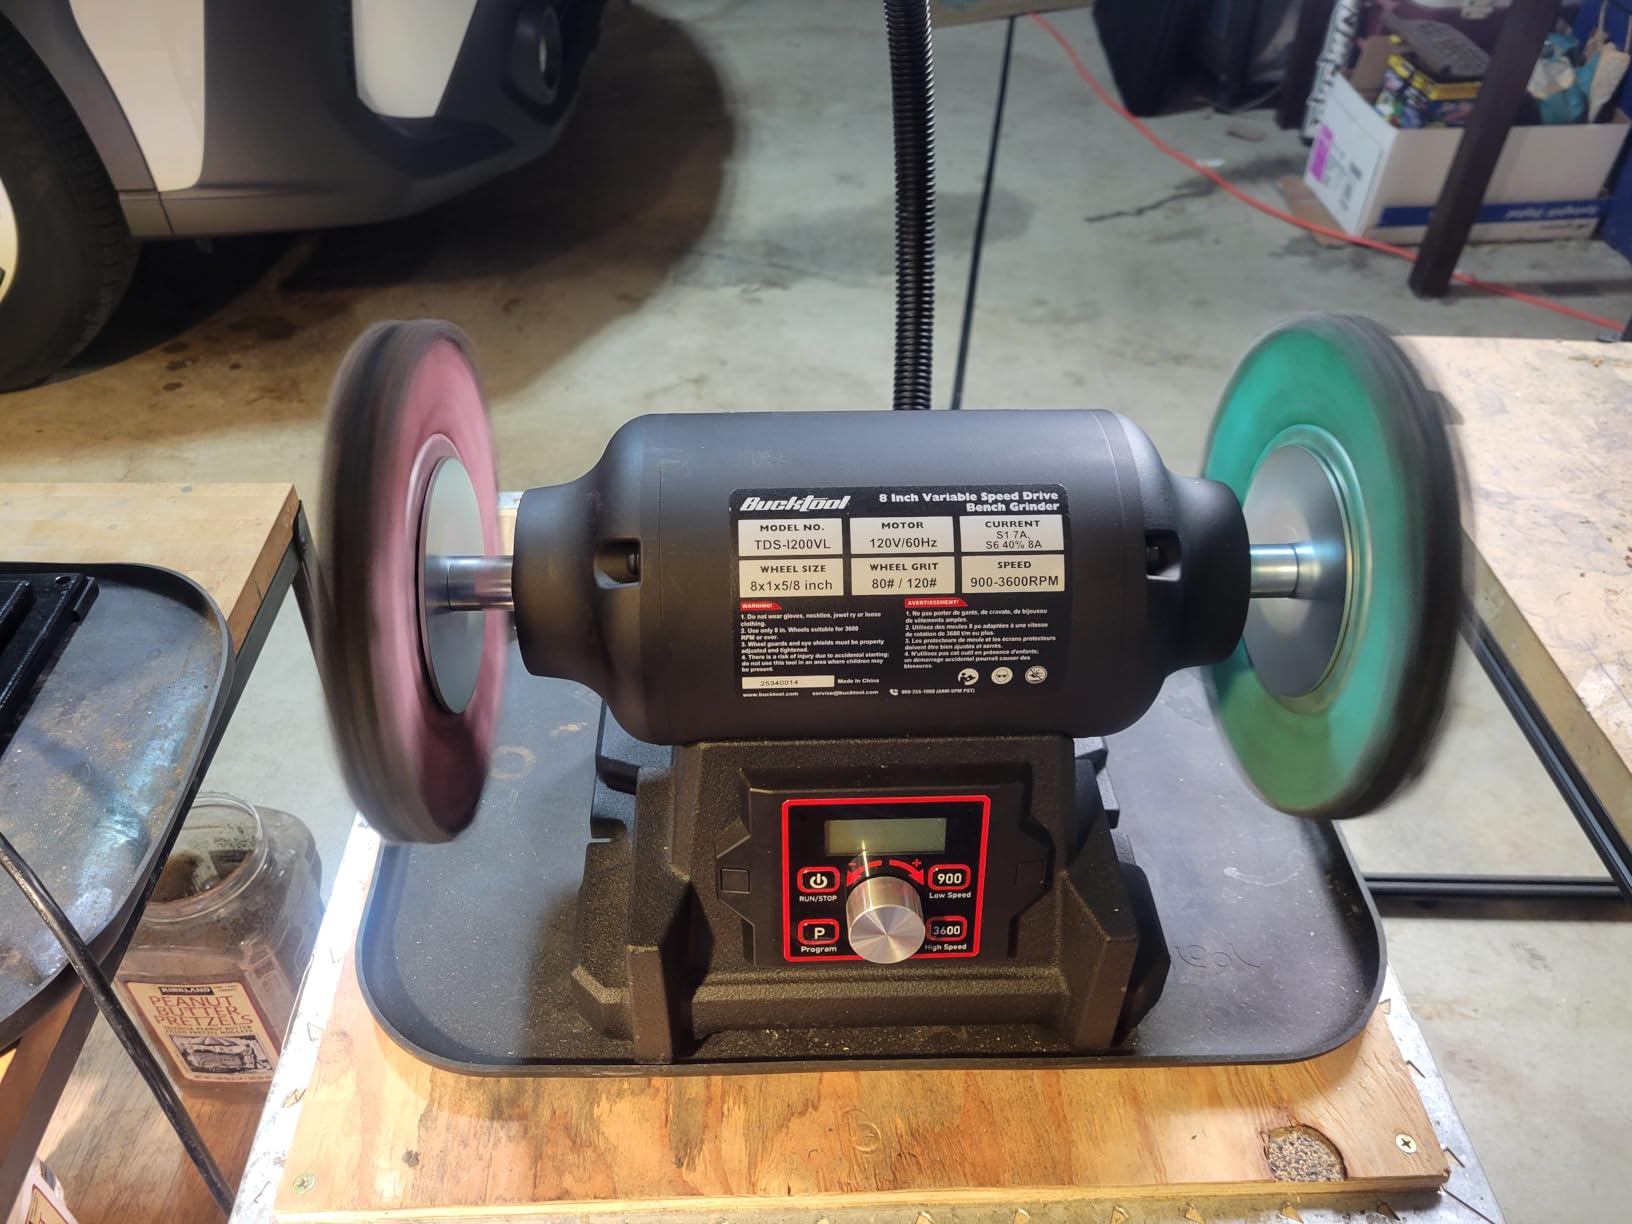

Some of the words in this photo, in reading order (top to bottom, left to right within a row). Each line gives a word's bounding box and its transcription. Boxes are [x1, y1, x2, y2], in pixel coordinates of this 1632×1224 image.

[879, 494, 887, 502] 8
[891, 493, 918, 502] Inch
[921, 492, 976, 502] Variable
[979, 492, 1016, 502] Speed
[1019, 491, 1058, 500] Drive
[740, 496, 850, 512] Bucktool
[966, 503, 1007, 512] Bench
[1010, 502, 1059, 511] Grinder
[985, 520, 1040, 528] CURRENT
[997, 531, 1011, 539] S1
[1013, 530, 1030, 540] 7A,
[870, 537, 938, 549] 120V/60Hz
[986, 541, 1000, 549] S6
[1002, 540, 1025, 549] 40%
[1028, 539, 1042, 548] 8A
[760, 565, 799, 573] WHEEL
[802, 565, 826, 573] SIZE
[869, 563, 908, 571] WHEEL
[911, 563, 938, 571] GRIT
[998, 561, 1031, 569] SPEED
[751, 580, 800, 592] 8x1x5/8
[805, 579, 833, 590] inch
[872, 578, 895, 589] 80#
[907, 577, 937, 588] 120#
[971, 575, 1059, 588] 900-3600RPM
[937, 873, 962, 884] 900
[814, 927, 825, 940] P
[933, 925, 960, 936] 3600
[801, 946, 837, 954] Program
[943, 943, 967, 951] Speed
[149, 996, 233, 1006] PEANUT
[155, 1006, 241, 1016] BUTTER
[154, 1015, 253, 1026] PRETZELS
